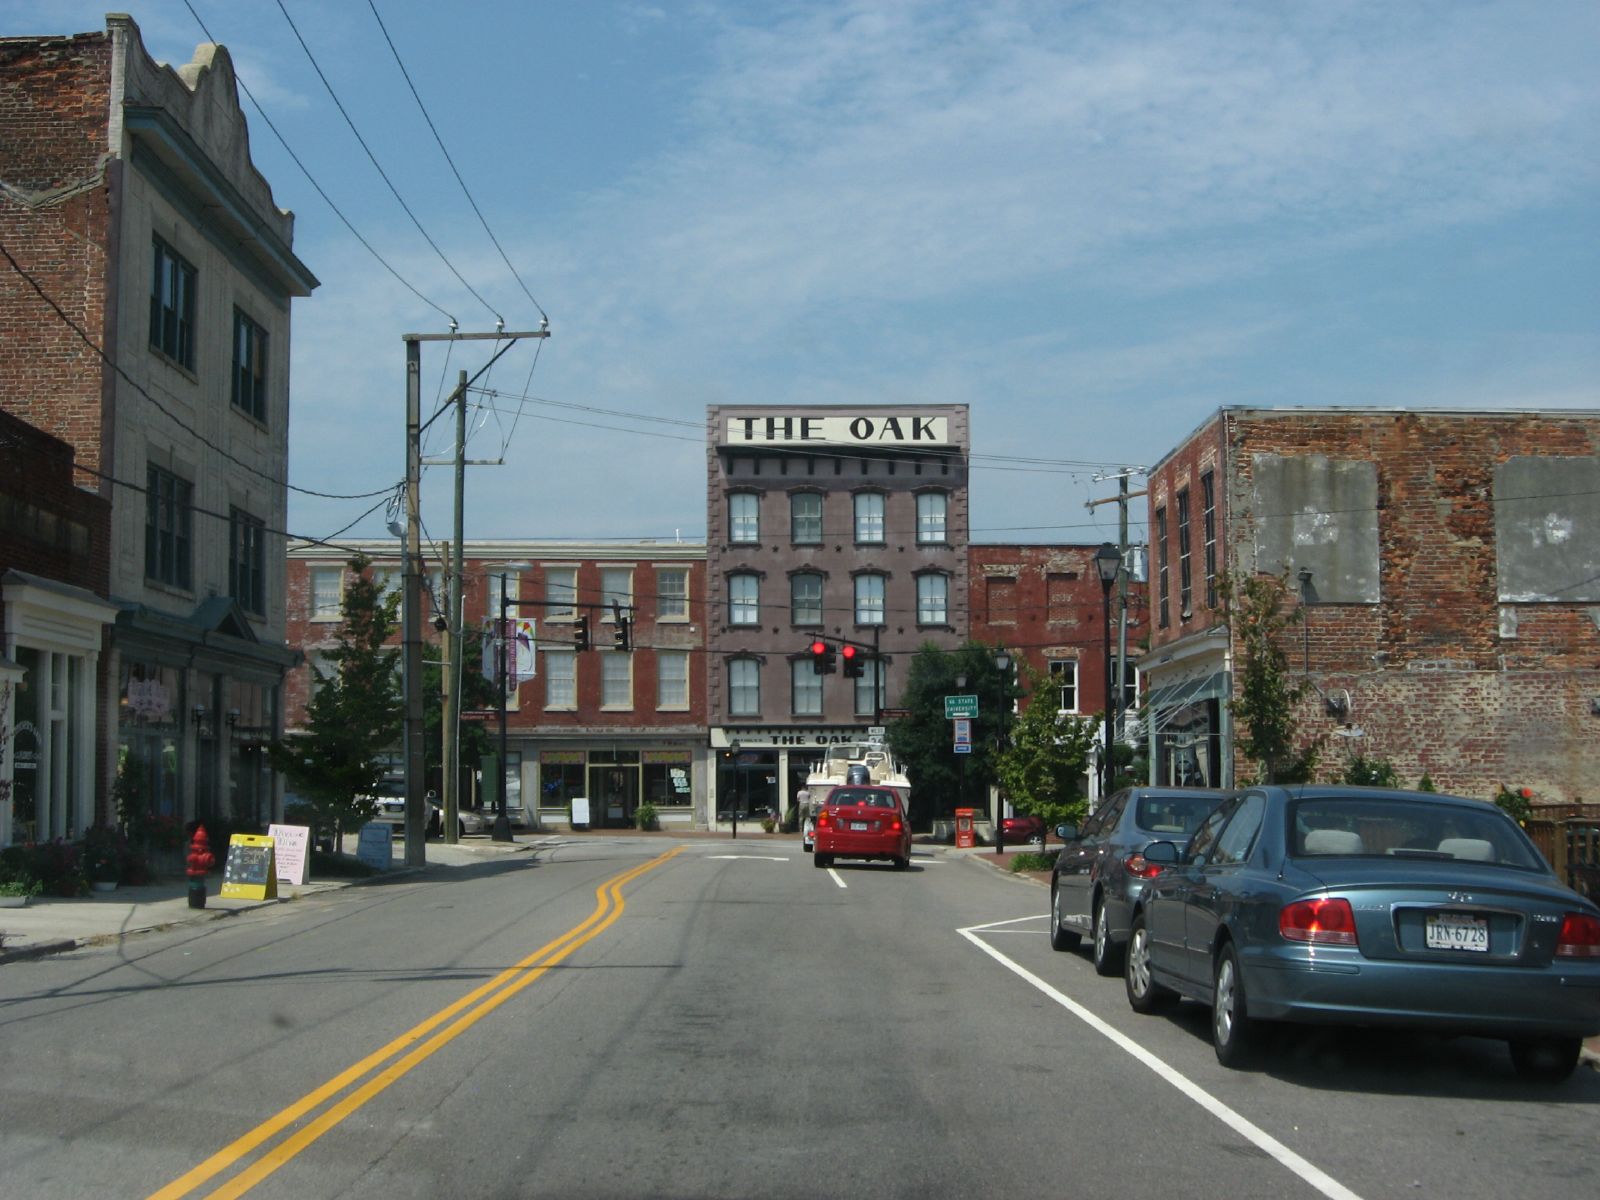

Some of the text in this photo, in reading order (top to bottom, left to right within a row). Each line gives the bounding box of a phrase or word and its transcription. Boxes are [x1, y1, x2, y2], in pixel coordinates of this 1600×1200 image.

[737, 417, 937, 440] THE OAK
[770, 735, 806, 745] THE
[815, 735, 854, 745] OAK
[1429, 923, 1486, 943] JRN-6728
